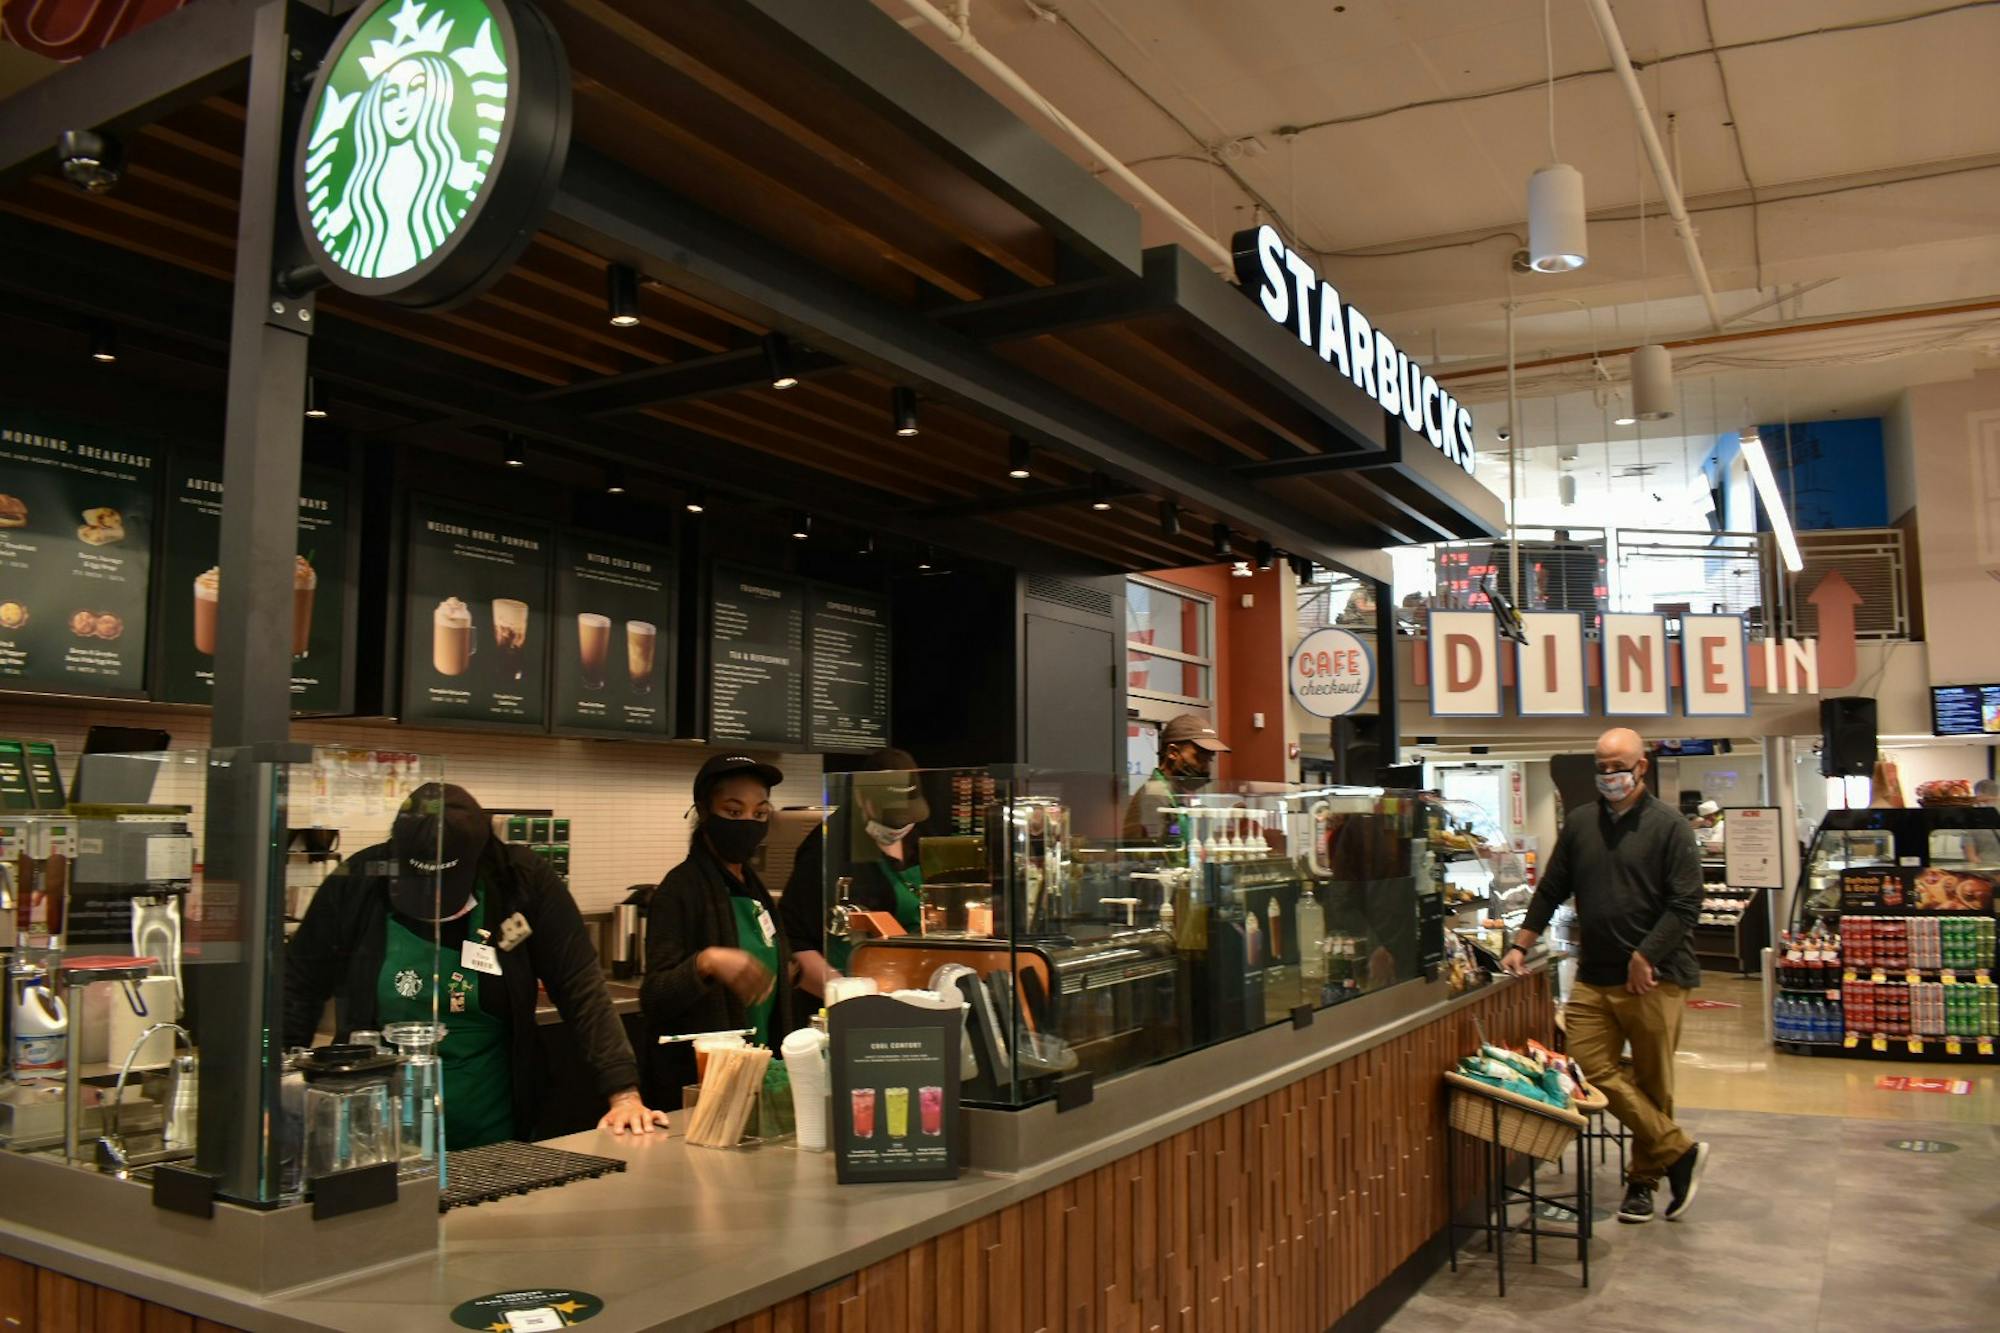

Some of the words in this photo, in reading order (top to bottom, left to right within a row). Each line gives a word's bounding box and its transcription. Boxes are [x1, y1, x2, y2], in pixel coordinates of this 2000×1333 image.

[1258, 225, 1476, 475] STARBUCKS
[1, 429, 73, 454] MORNING,
[77, 444, 152, 469] BREAKFAST
[427, 520, 469, 537] WELCOME
[501, 535, 540, 551] PUMPKIN
[1299, 649, 1361, 677] CAFE
[1764, 637, 1819, 695] IN
[1300, 679, 1362, 696] checkout
[870, 1042, 889, 1050] COOL
[890, 1041, 922, 1050] COMFORT
